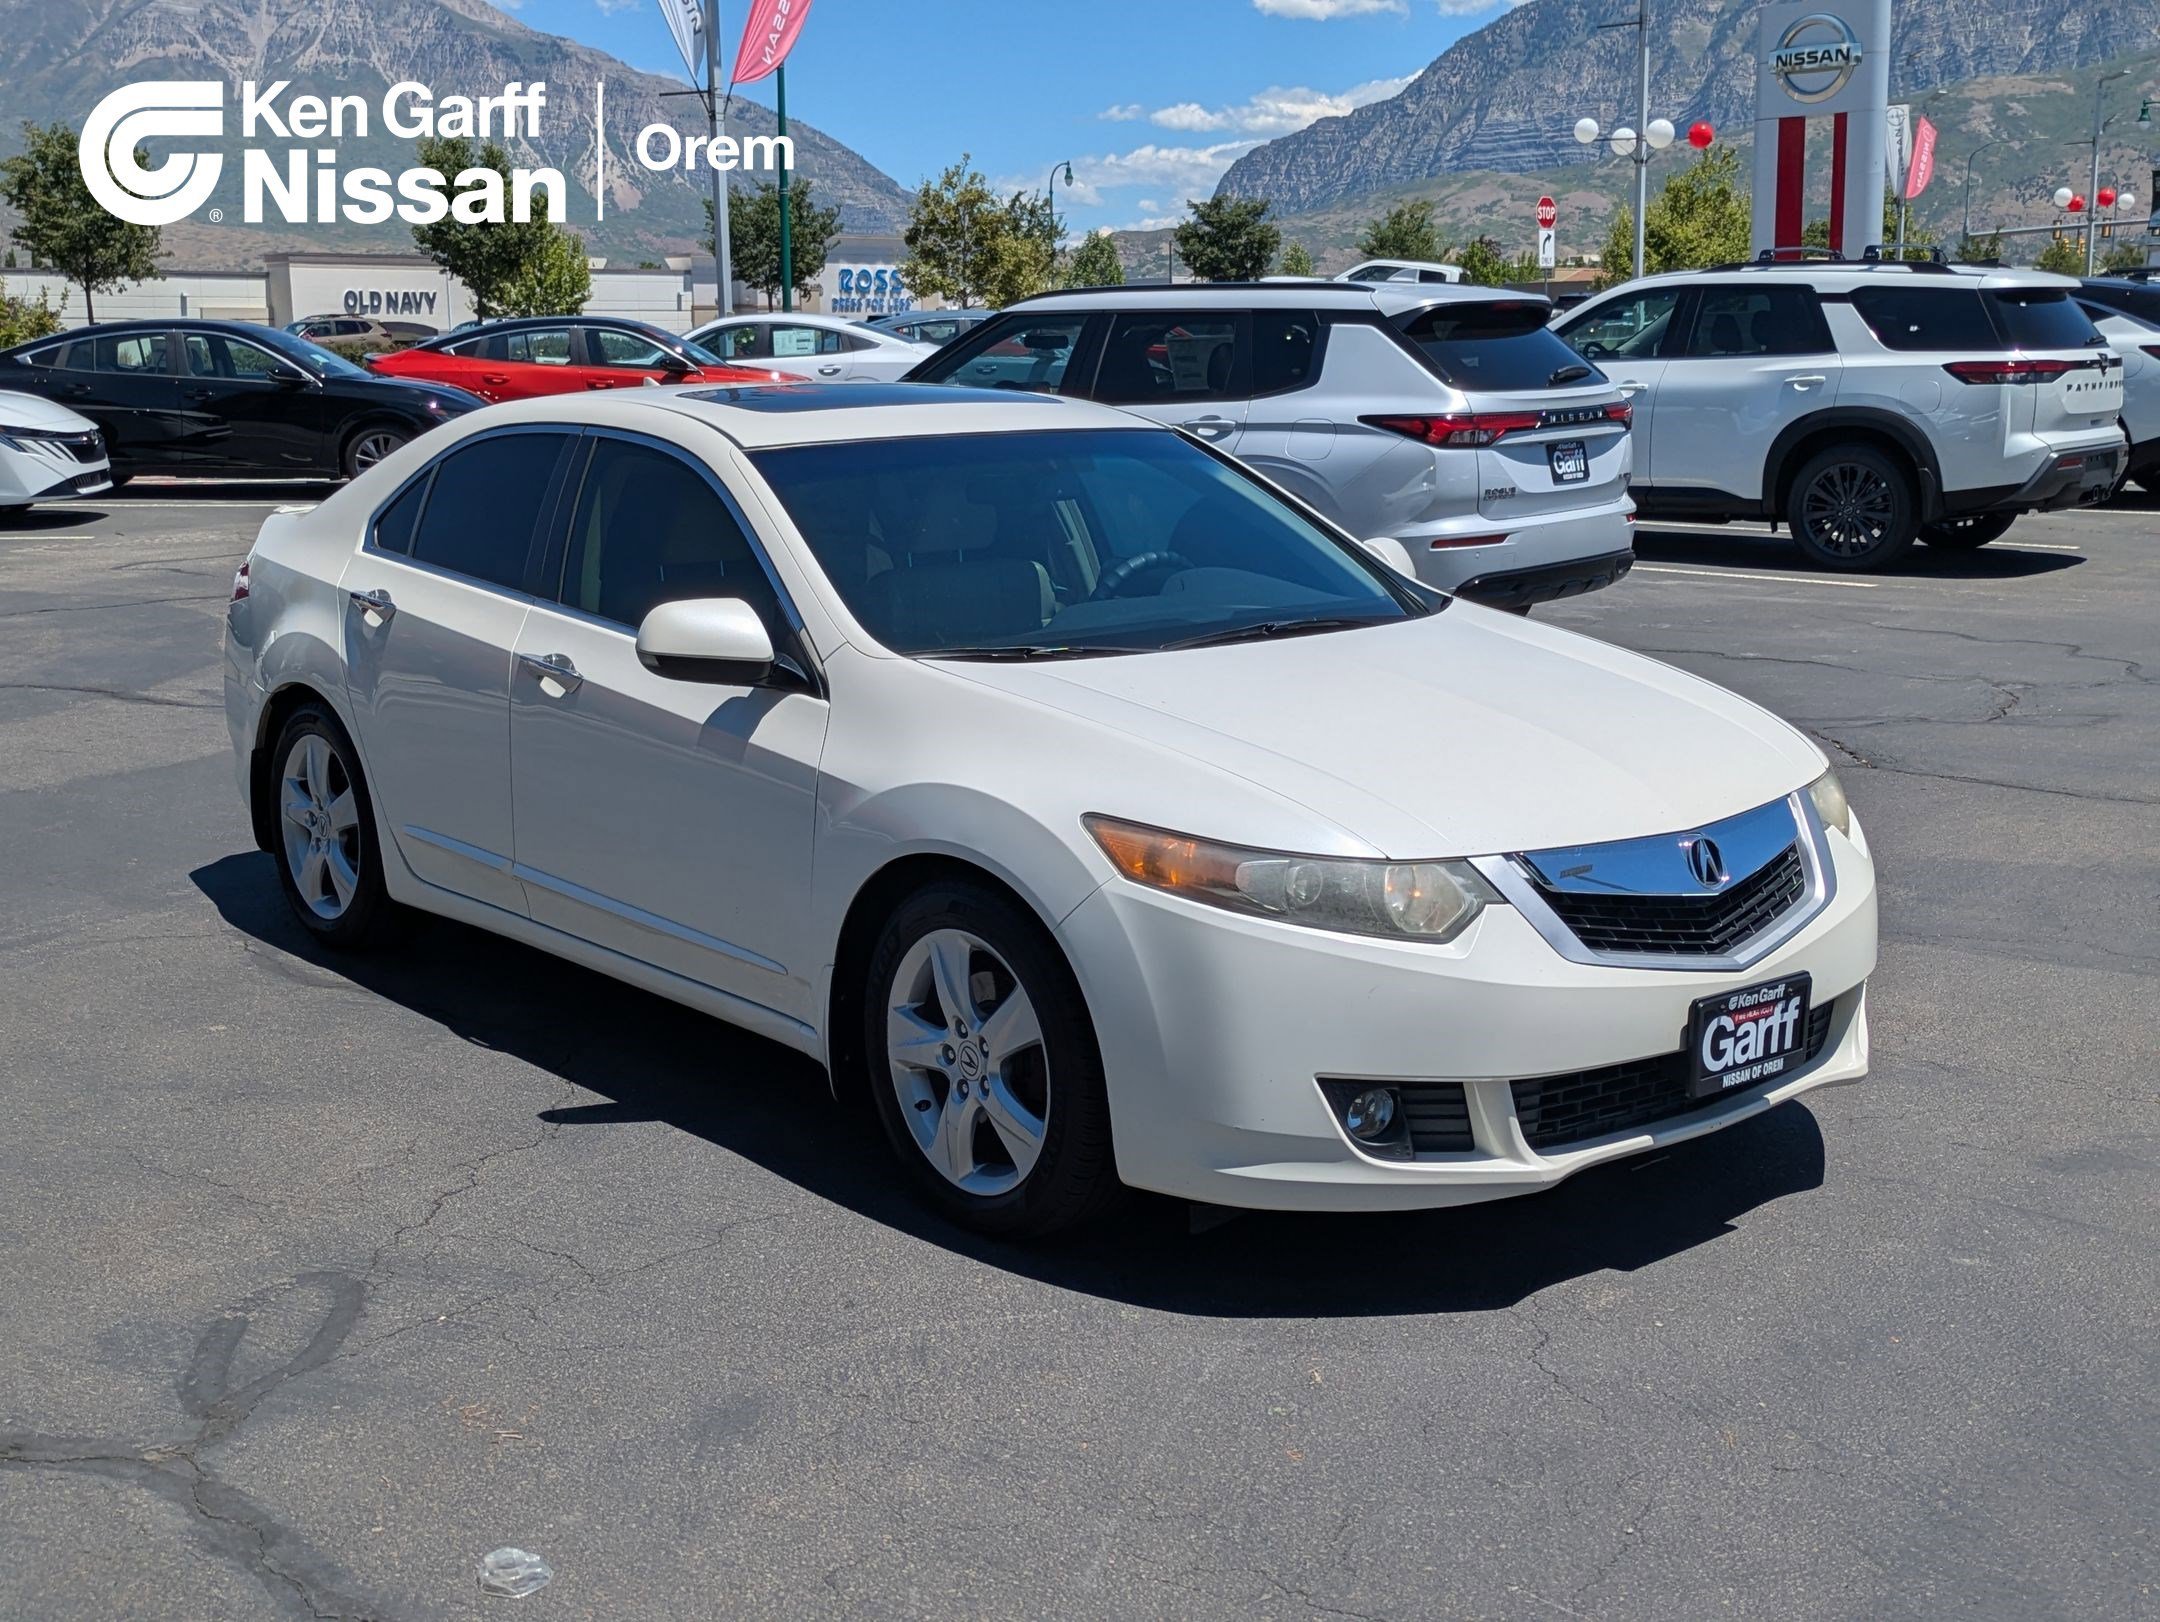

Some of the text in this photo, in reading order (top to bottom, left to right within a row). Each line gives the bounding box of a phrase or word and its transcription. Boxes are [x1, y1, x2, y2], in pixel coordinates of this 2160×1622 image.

[1776, 47, 1851, 68] NISSAN
[1537, 206, 1556, 220] STOP
[839, 268, 905, 293] ROSS
[344, 290, 437, 315] OLD NAVY
[2066, 380, 2124, 392] PATHFIND
[1737, 984, 1786, 1009] Ken Garff
[1702, 996, 1800, 1072] Garff
[1722, 1057, 1784, 1088] NISSAN OF OREM
